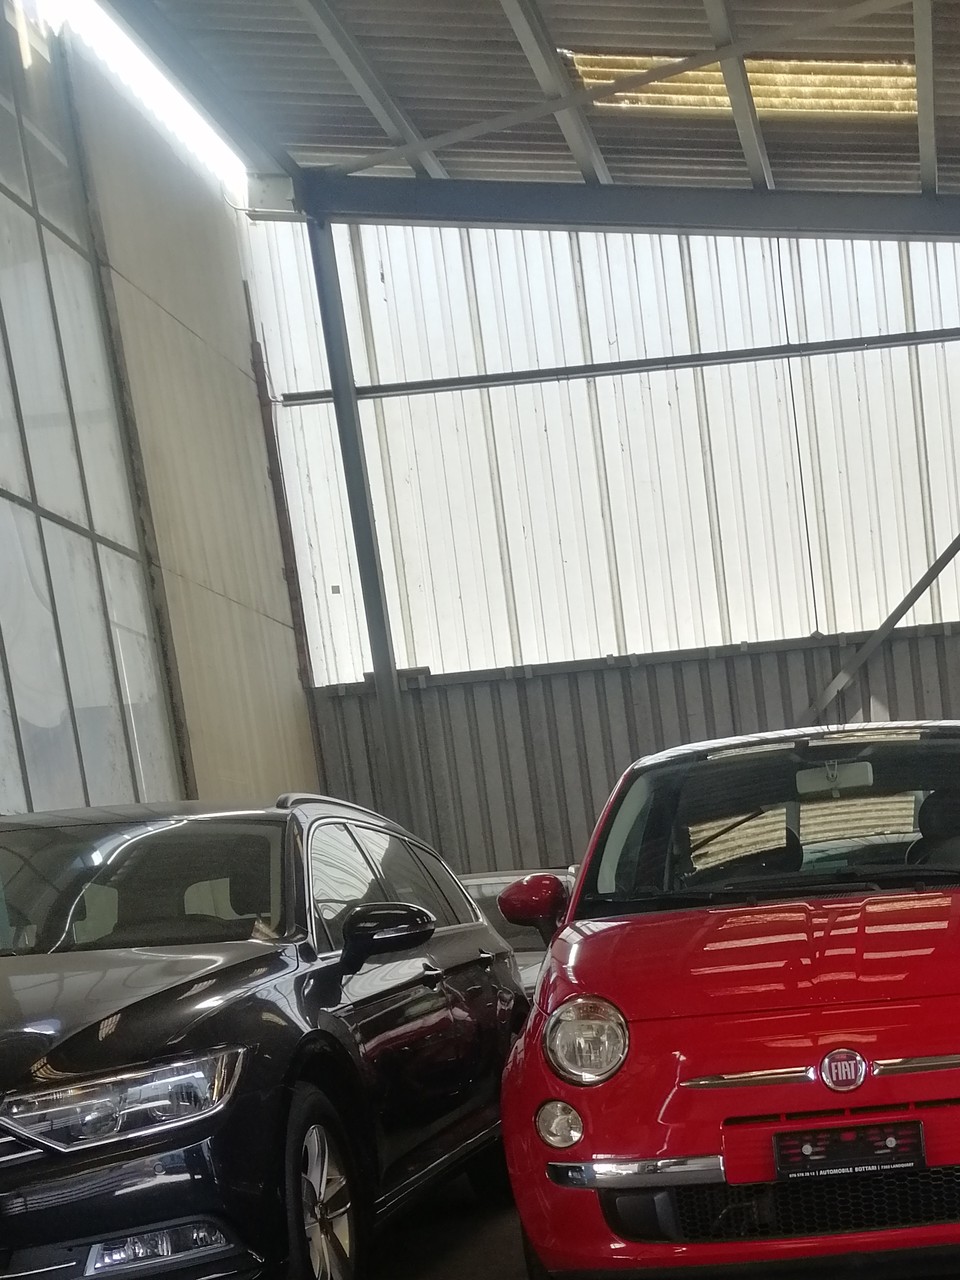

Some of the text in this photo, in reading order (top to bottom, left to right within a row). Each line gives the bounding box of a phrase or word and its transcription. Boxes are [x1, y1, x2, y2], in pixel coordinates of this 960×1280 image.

[831, 1060, 856, 1081] FIAT
[819, 1167, 853, 1176] AUTOMOBILE
[854, 1165, 877, 1173] BOTTARI
